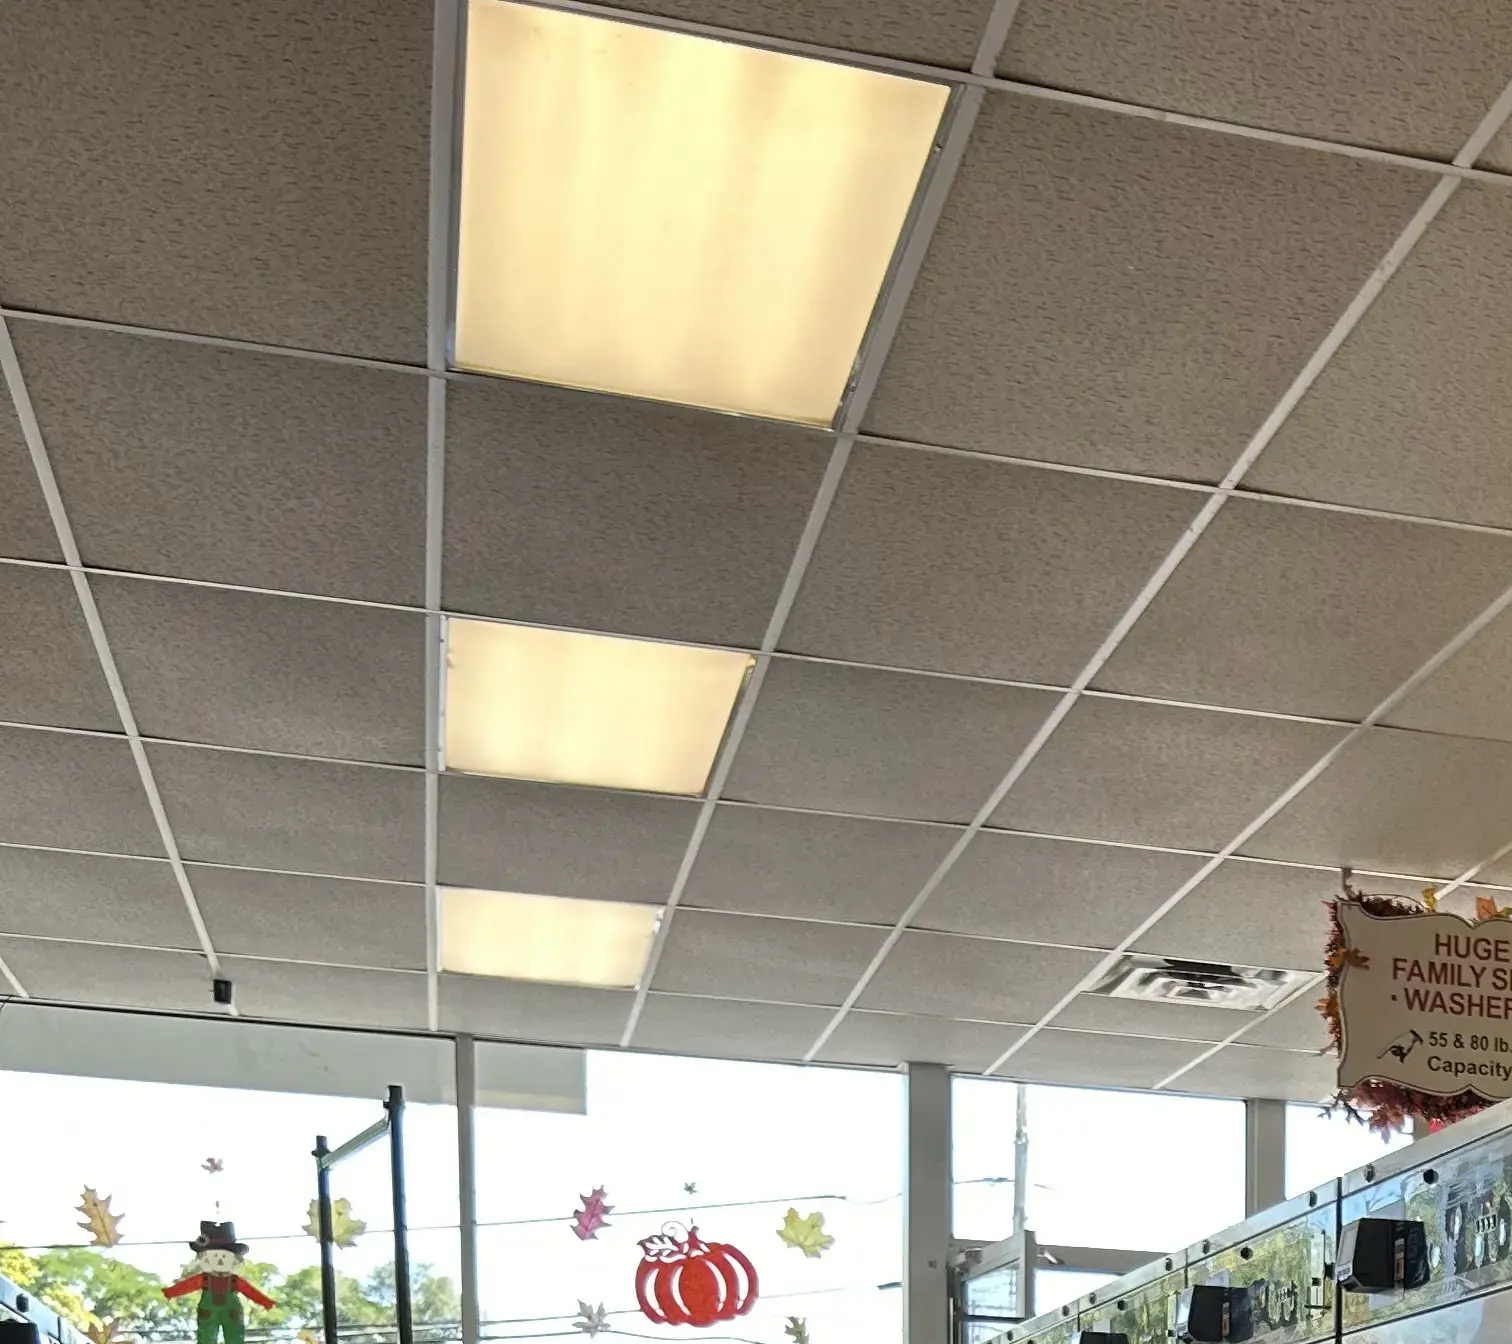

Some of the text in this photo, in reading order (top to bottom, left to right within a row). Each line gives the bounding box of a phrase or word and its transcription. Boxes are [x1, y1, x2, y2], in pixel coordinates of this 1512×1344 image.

[1434, 932, 1511, 963] HUGE
[1392, 957, 1488, 988] FAMILY
[1428, 1031, 1448, 1048] 55
[1453, 1034, 1465, 1049] &
[1471, 1035, 1489, 1051] 80
